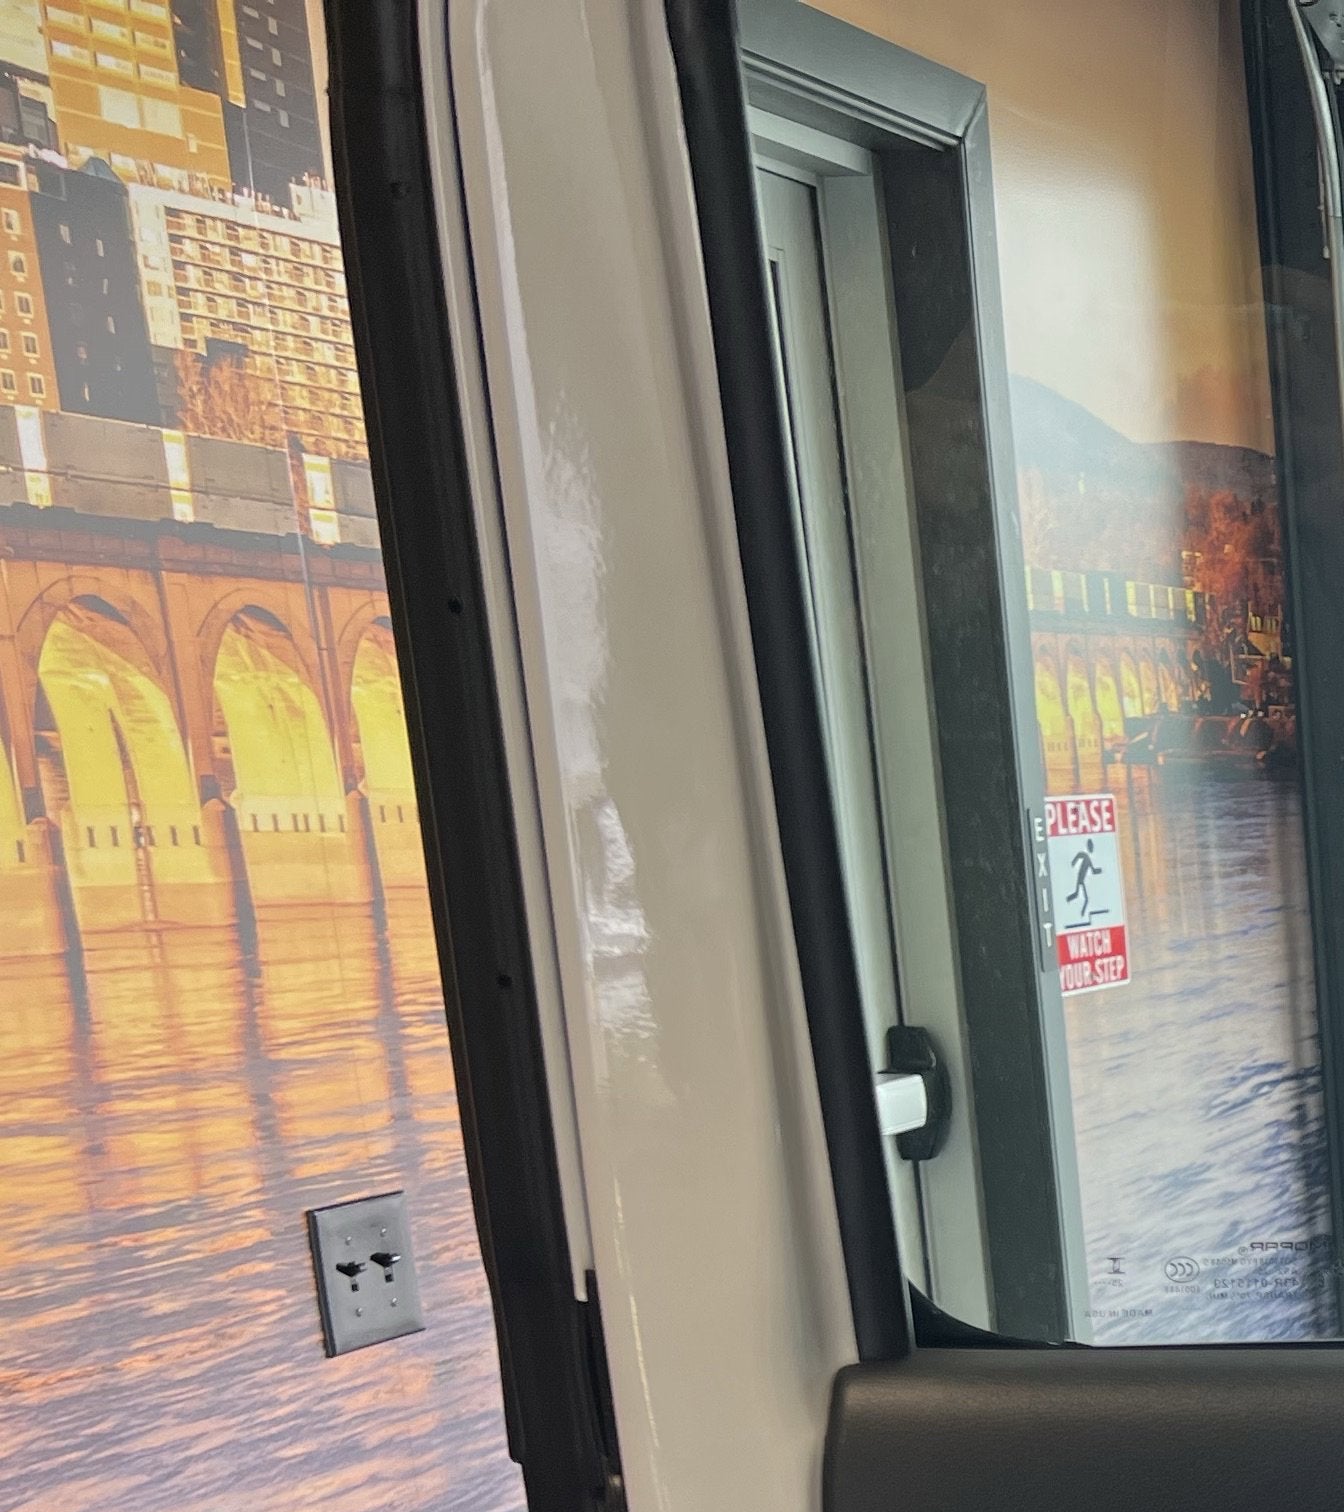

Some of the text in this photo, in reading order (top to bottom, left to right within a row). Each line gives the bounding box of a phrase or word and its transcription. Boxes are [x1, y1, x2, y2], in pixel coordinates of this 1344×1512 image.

[1045, 800, 1113, 835] PLEASE
[1034, 817, 1053, 947] EXIT
[1066, 930, 1112, 960] WATCH
[1095, 955, 1125, 983] STEP
